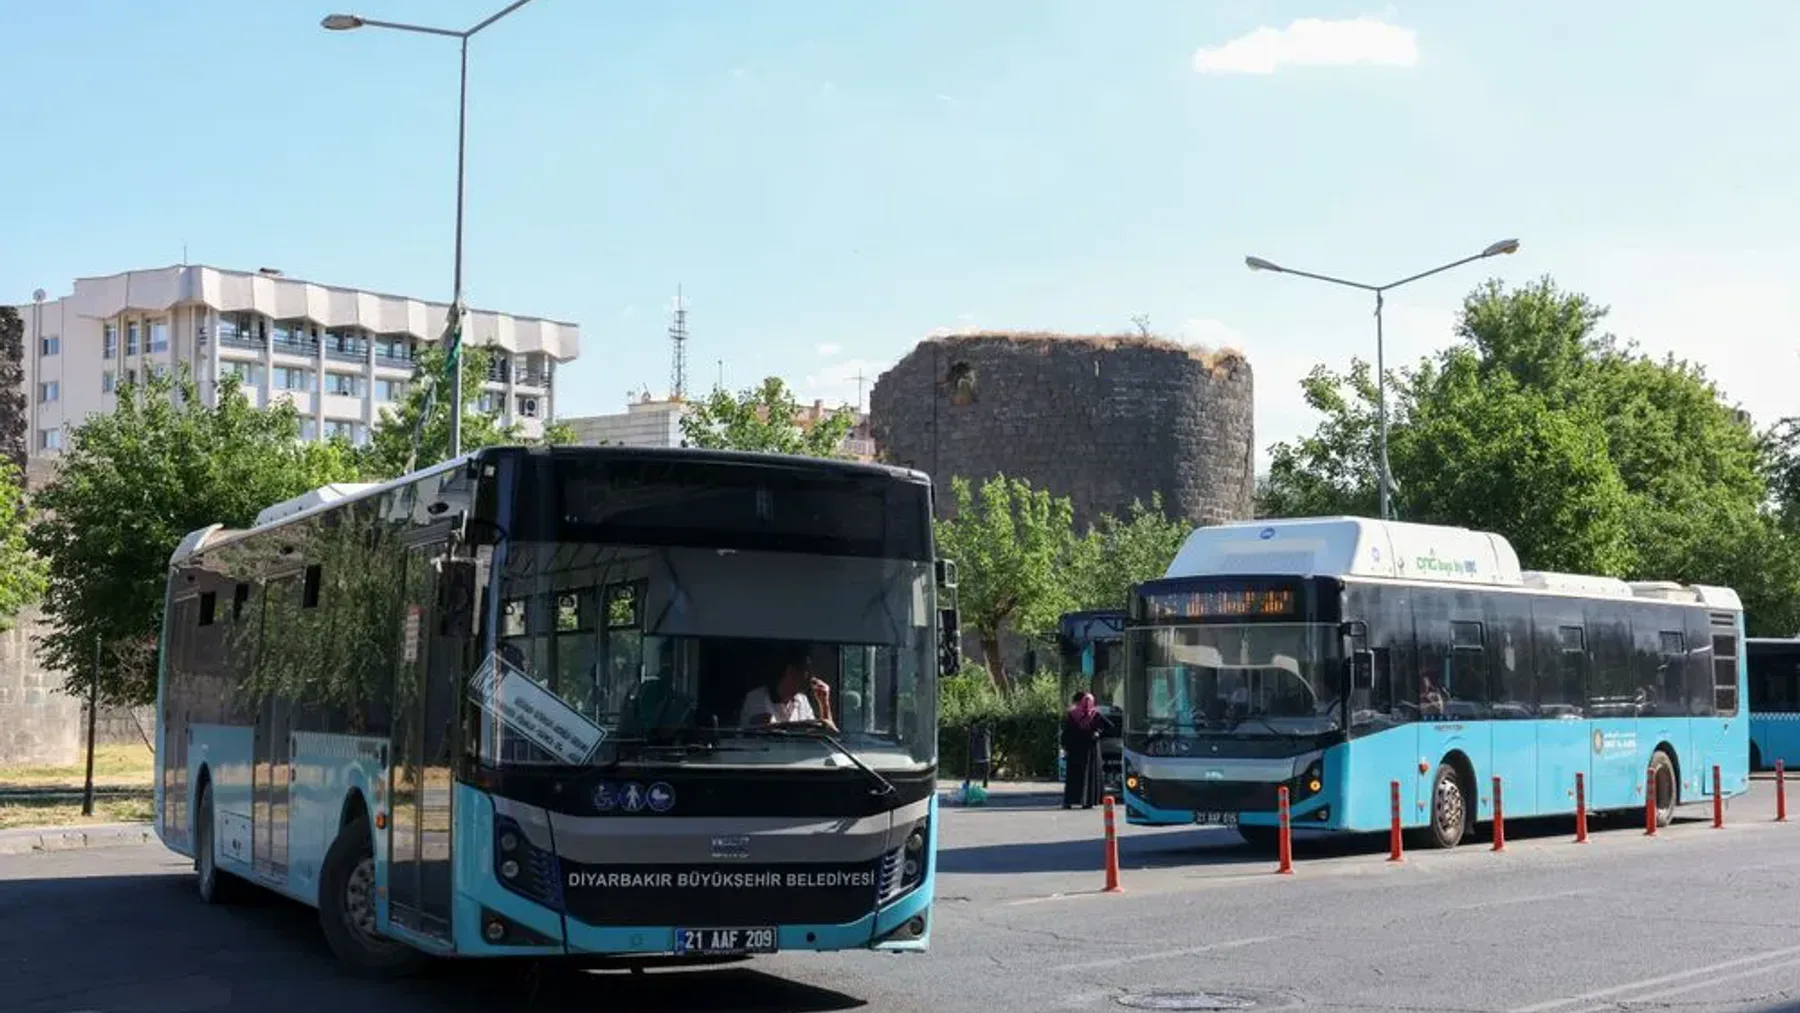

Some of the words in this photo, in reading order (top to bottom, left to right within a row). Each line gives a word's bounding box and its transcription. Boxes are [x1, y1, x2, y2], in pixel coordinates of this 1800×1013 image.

[677, 869, 782, 889] BÜYÜKŞEHİR
[786, 868, 875, 887] BELEDİYESİ
[685, 931, 702, 949] 21
[711, 930, 739, 949] AAF
[745, 929, 772, 948] 209
